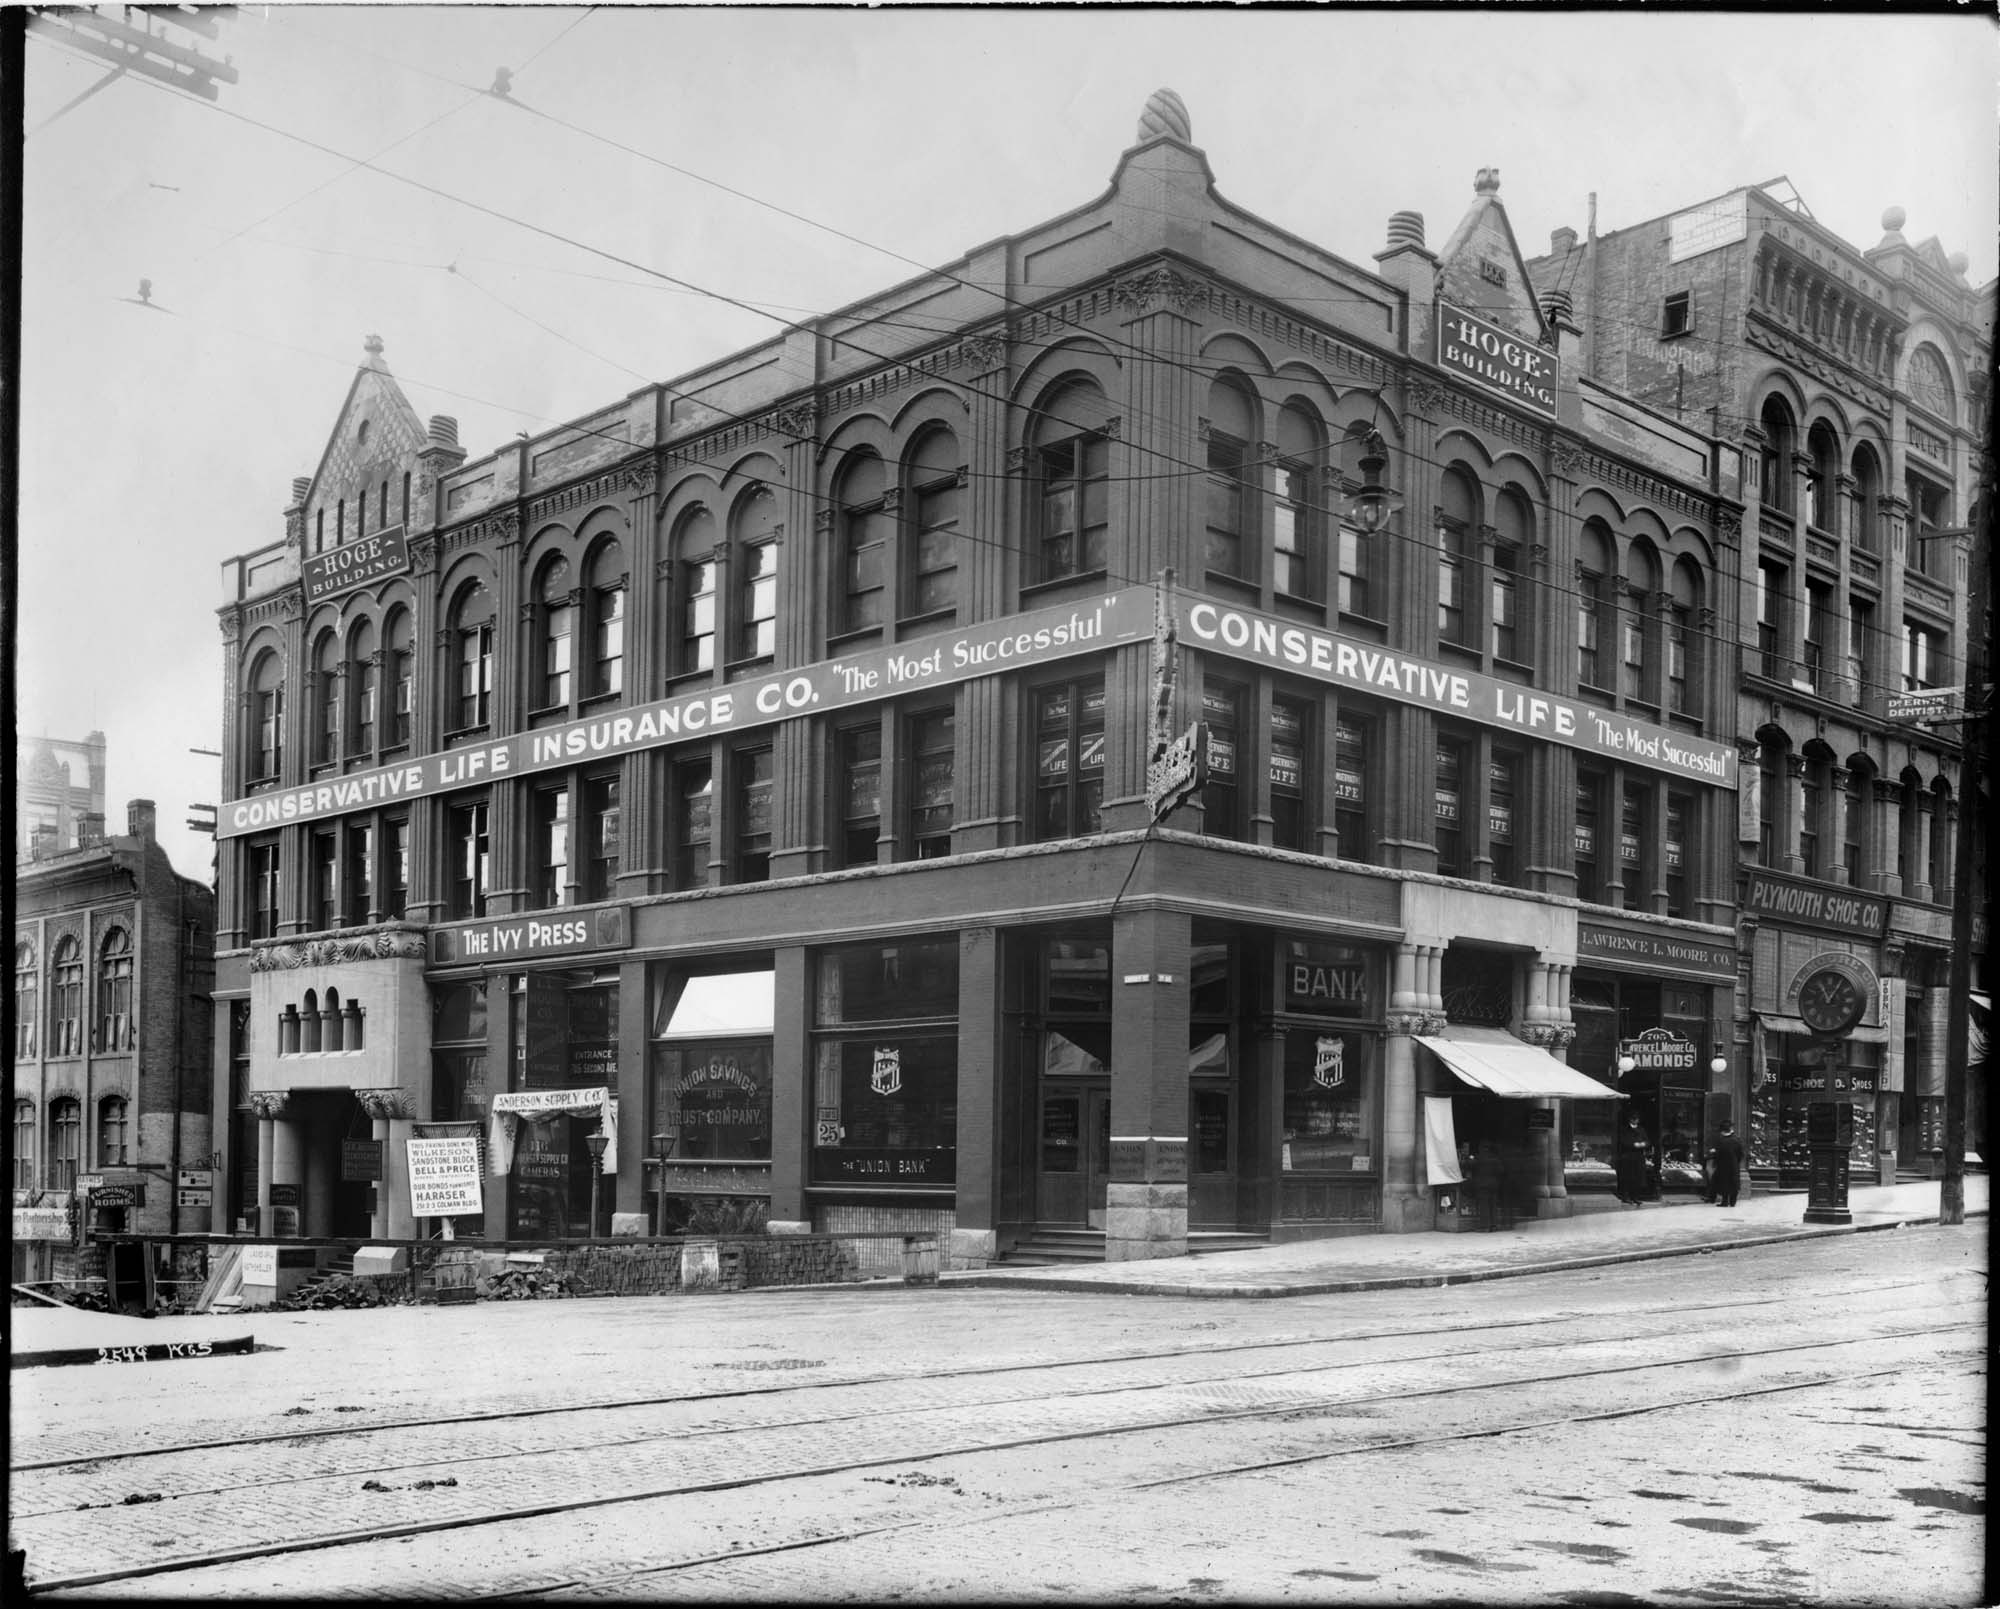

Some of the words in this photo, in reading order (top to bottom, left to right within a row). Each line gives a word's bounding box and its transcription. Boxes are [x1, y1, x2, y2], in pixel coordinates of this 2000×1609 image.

[1458, 319, 1541, 378] HOGE
[324, 537, 382, 577] HOGE
[1189, 603, 1470, 709] CONSERVATIVE
[1496, 688, 1578, 737] LIFE
[1626, 730, 1660, 760] Most
[233, 767, 424, 829] CONSERVATIVE
[439, 744, 510, 786] LIFE
[533, 696, 734, 764] INSURANCE
[756, 677, 819, 714] CO.
[887, 647, 942, 684] Most
[1049, 760, 1067, 771] LIFE
[1270, 768, 1297, 784] LIFE
[1752, 880, 1824, 918] PLYMOUTH
[1824, 896, 1861, 925] SHOE
[1862, 903, 1881, 930] CO.
[528, 919, 588, 949] PRESS
[1581, 931, 1648, 953] LAWRENCE
[1666, 944, 1708, 962] MOORE
[1712, 952, 1731, 966] CO.
[1293, 965, 1367, 1002] BANK
[674, 1065, 707, 1098] UNION
[709, 1063, 758, 1098] SAVINGS
[499, 1094, 541, 1110] ANDERSON
[545, 1091, 578, 1108] SUPPLY
[669, 1109, 703, 1127] TRUST
[819, 1124, 839, 1144] 25
[411, 1156, 451, 1166] SANDSTONE
[452, 1155, 476, 1165] BLOCK
[412, 1148, 471, 1157] WILKESON
[415, 1166, 437, 1175] BELL
[439, 1166, 446, 1174] &
[446, 1164, 476, 1174] PRICE
[520, 1166, 560, 1178] CAMERAS
[90, 1187, 135, 1200] FURNISHED
[427, 1182, 449, 1190] BONDS
[436, 1200, 461, 1208] COLMAN
